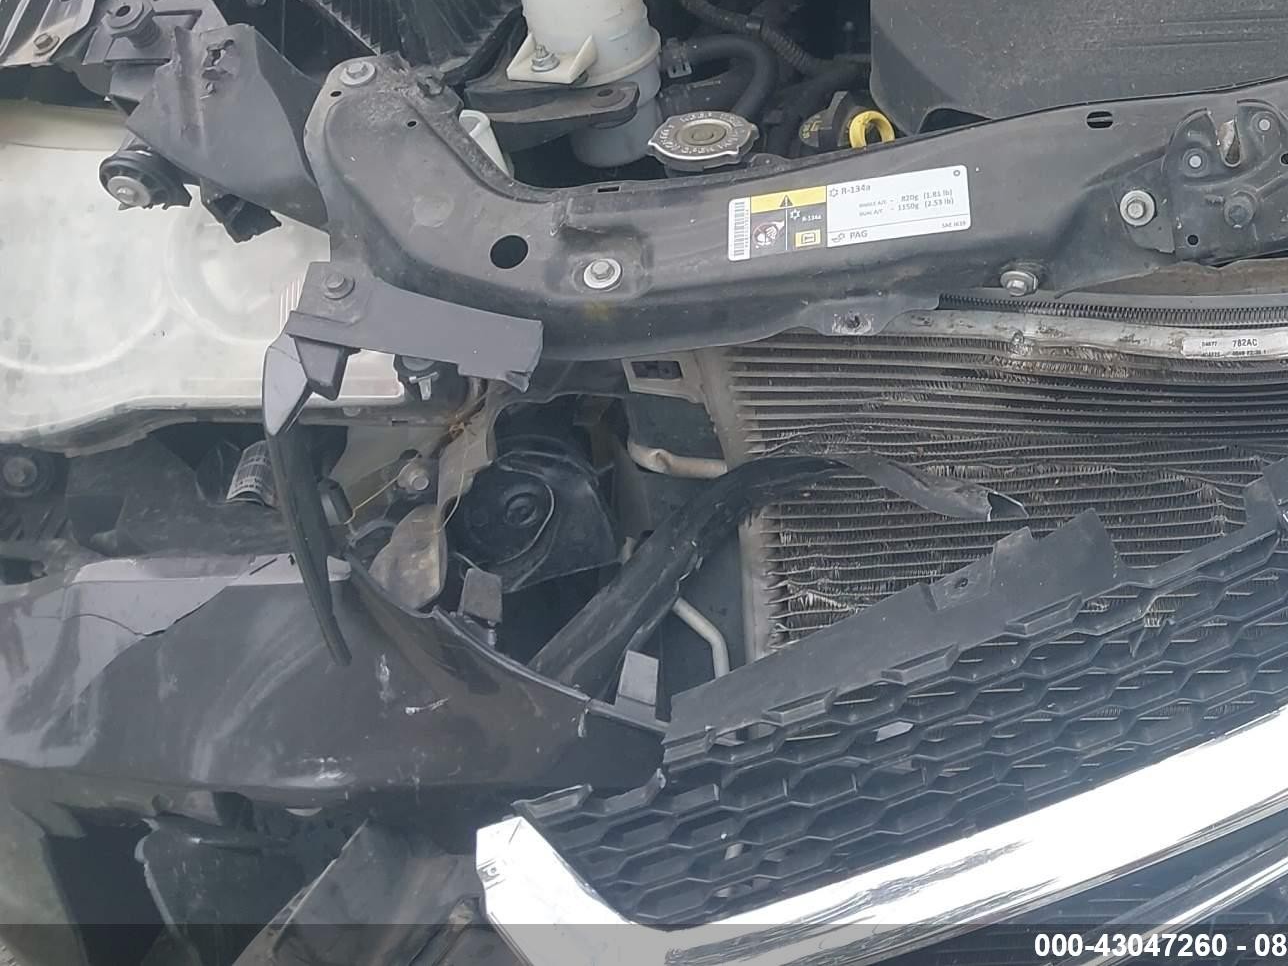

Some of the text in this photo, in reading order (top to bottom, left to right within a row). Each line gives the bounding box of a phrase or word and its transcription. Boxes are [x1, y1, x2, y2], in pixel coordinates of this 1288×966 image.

[841, 184, 871, 195] R-134a
[850, 230, 868, 240] PAG
[1232, 338, 1258, 347] 782AC
